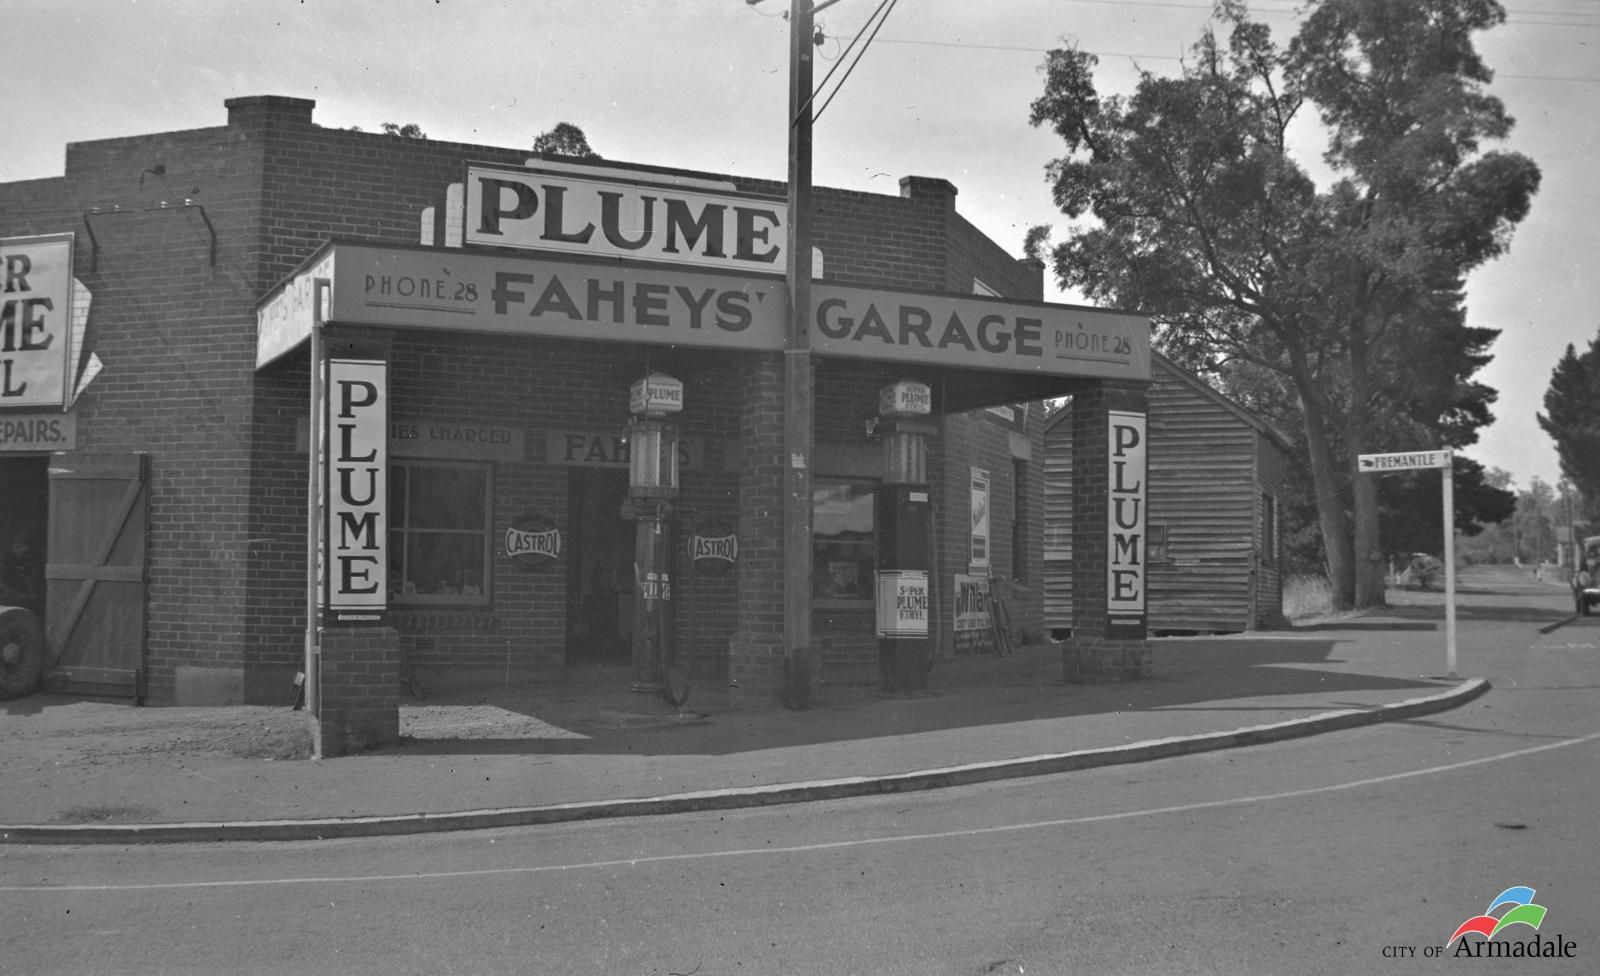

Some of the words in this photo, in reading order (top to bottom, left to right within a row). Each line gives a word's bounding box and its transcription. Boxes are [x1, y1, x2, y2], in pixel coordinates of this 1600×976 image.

[477, 176, 783, 264] PLUME
[815, 297, 1043, 357] GARAGE
[1055, 330, 1109, 353] PHONE
[1113, 336, 1132, 355] 28
[648, 387, 681, 401] PLUME
[0, 420, 67, 443] PAIRS.
[430, 425, 512, 445] CHARGED
[1375, 453, 1436, 469] FREMANTLE
[337, 379, 381, 596] PLUME
[1111, 424, 1141, 603] PLUME
[507, 530, 560, 556] CASTROL
[896, 596, 928, 609] PLUME
